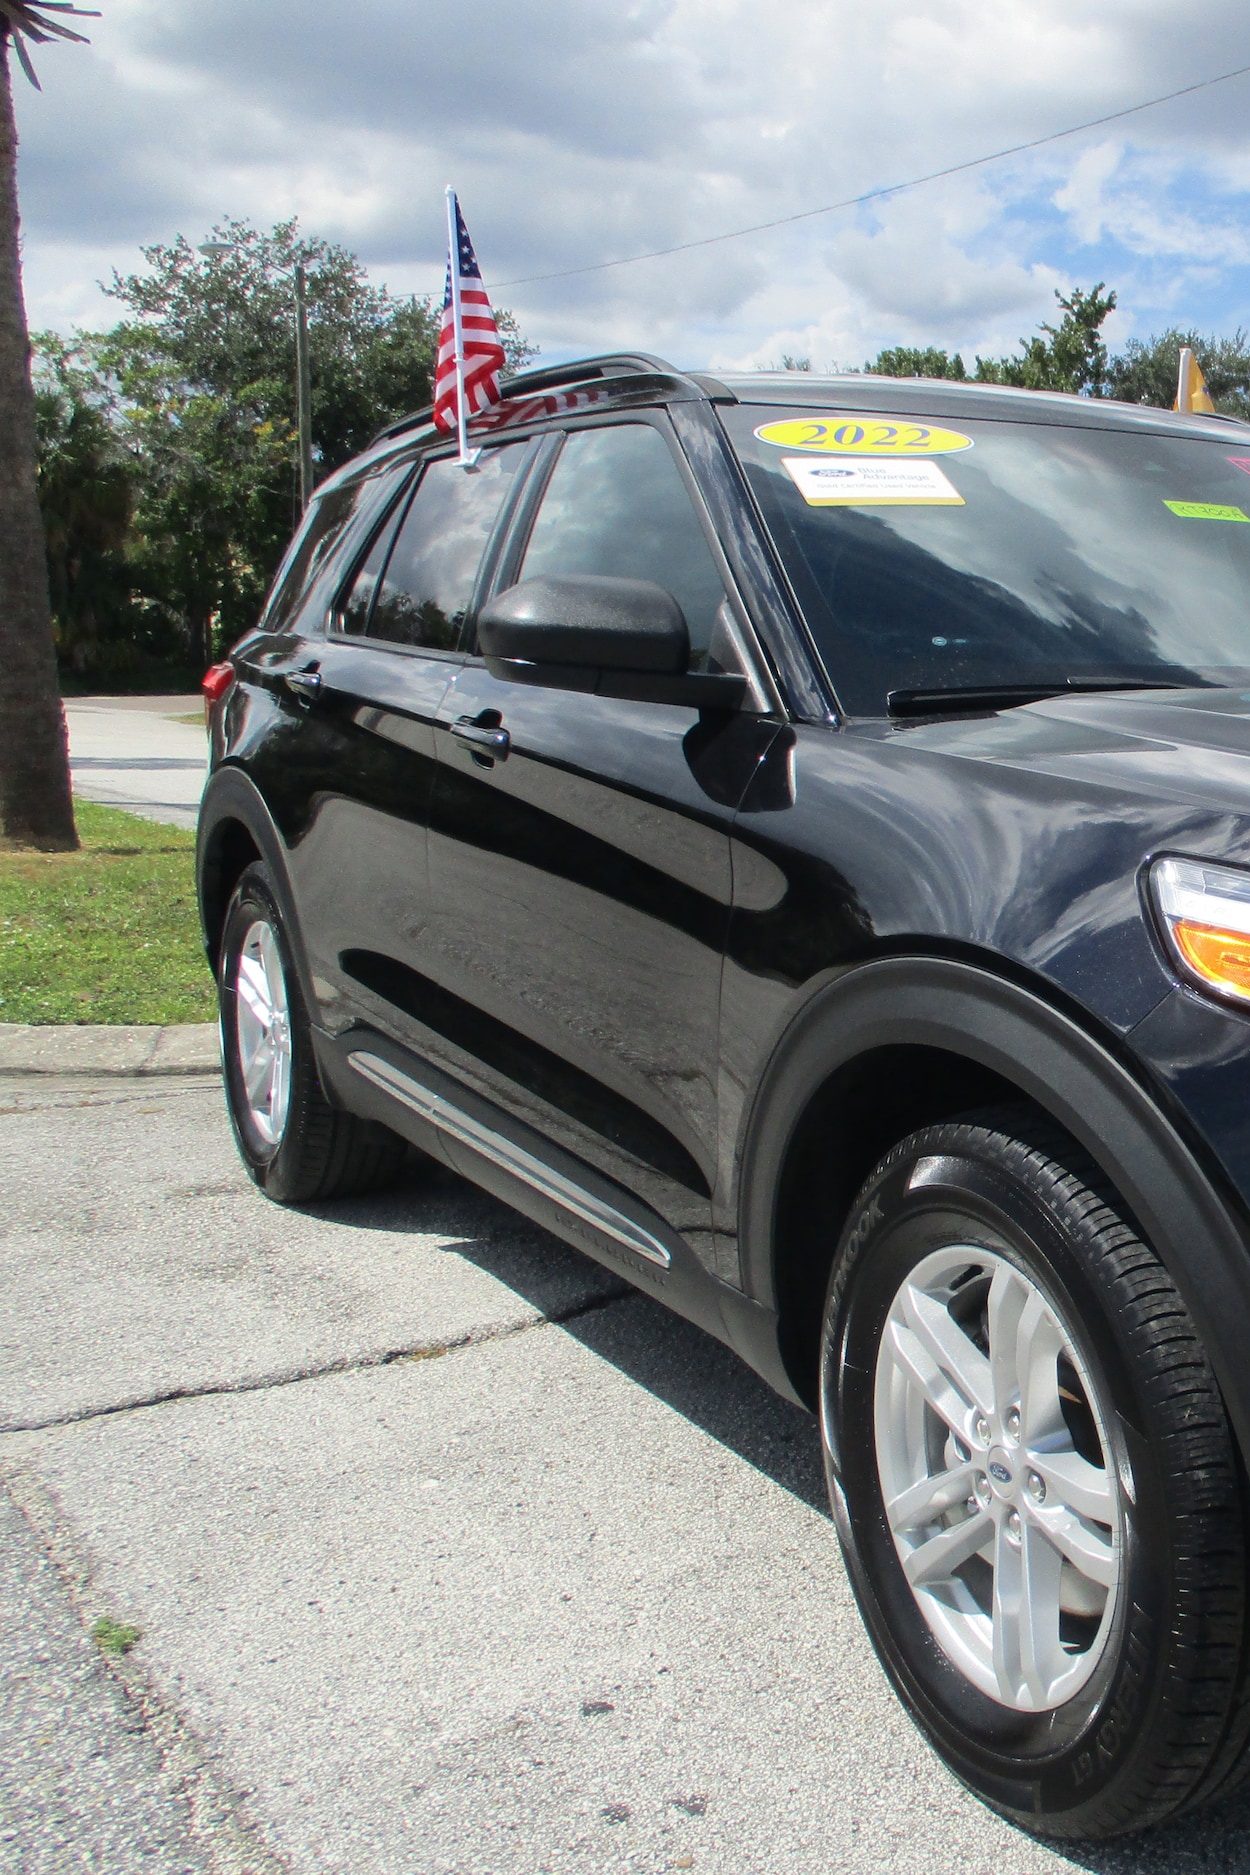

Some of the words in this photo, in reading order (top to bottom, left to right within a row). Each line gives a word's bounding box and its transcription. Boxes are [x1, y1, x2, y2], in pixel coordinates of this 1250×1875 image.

[799, 424, 931, 447] 2022
[863, 473, 930, 481] Advantage
[992, 1465, 1007, 1480] Ford
